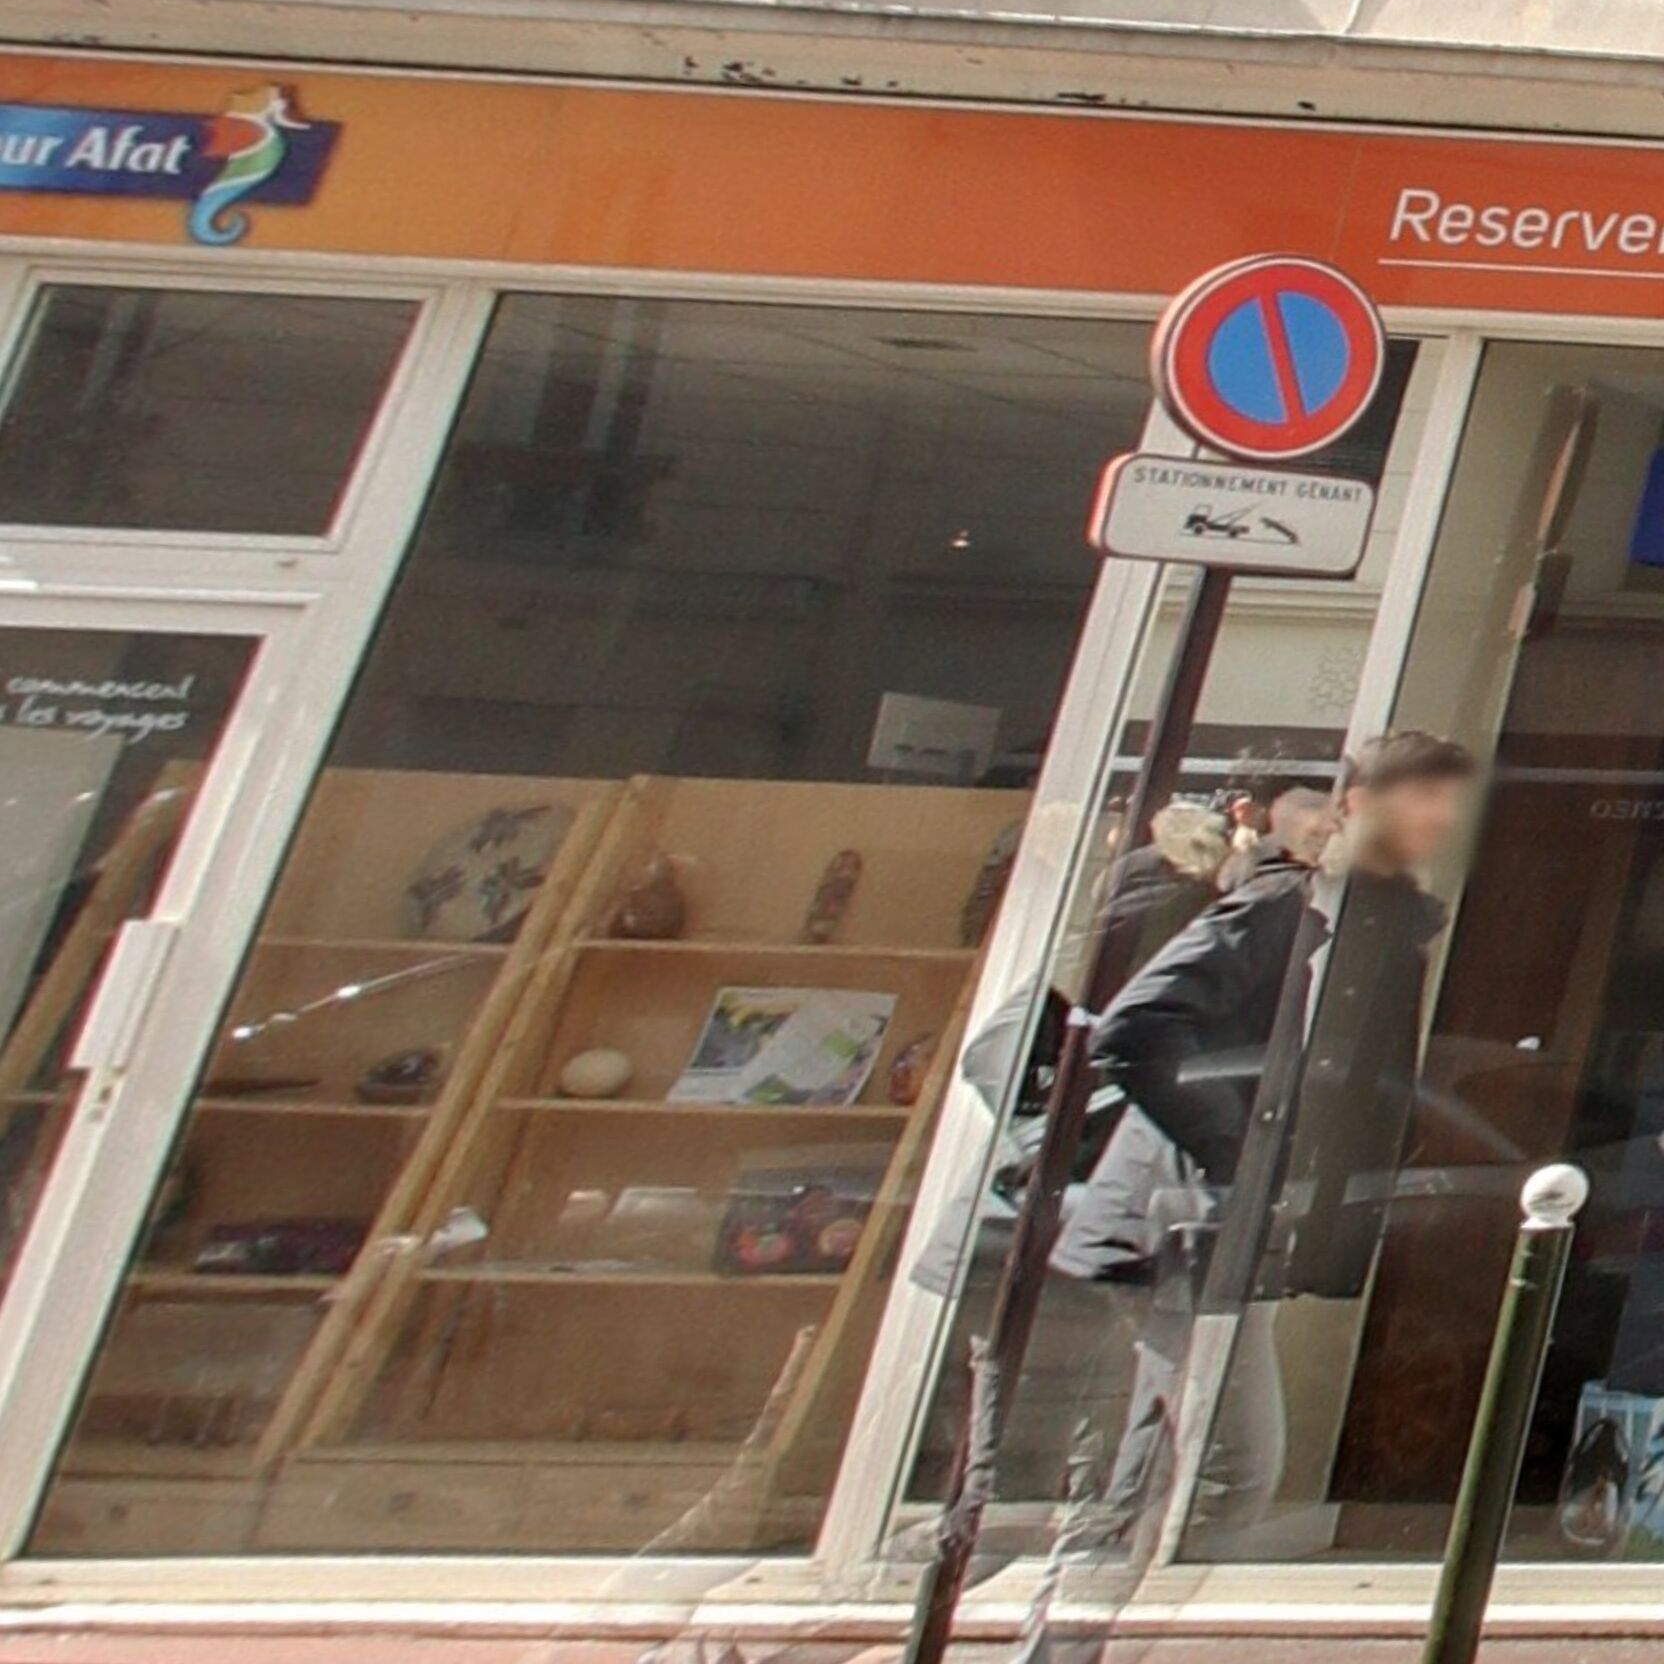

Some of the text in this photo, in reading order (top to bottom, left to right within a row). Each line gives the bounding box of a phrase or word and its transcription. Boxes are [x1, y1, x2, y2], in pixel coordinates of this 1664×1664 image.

[0, 124, 192, 174] ur Afat
[1133, 466, 1288, 496] STATIONNEMENT
[65, 709, 190, 745] voyages
